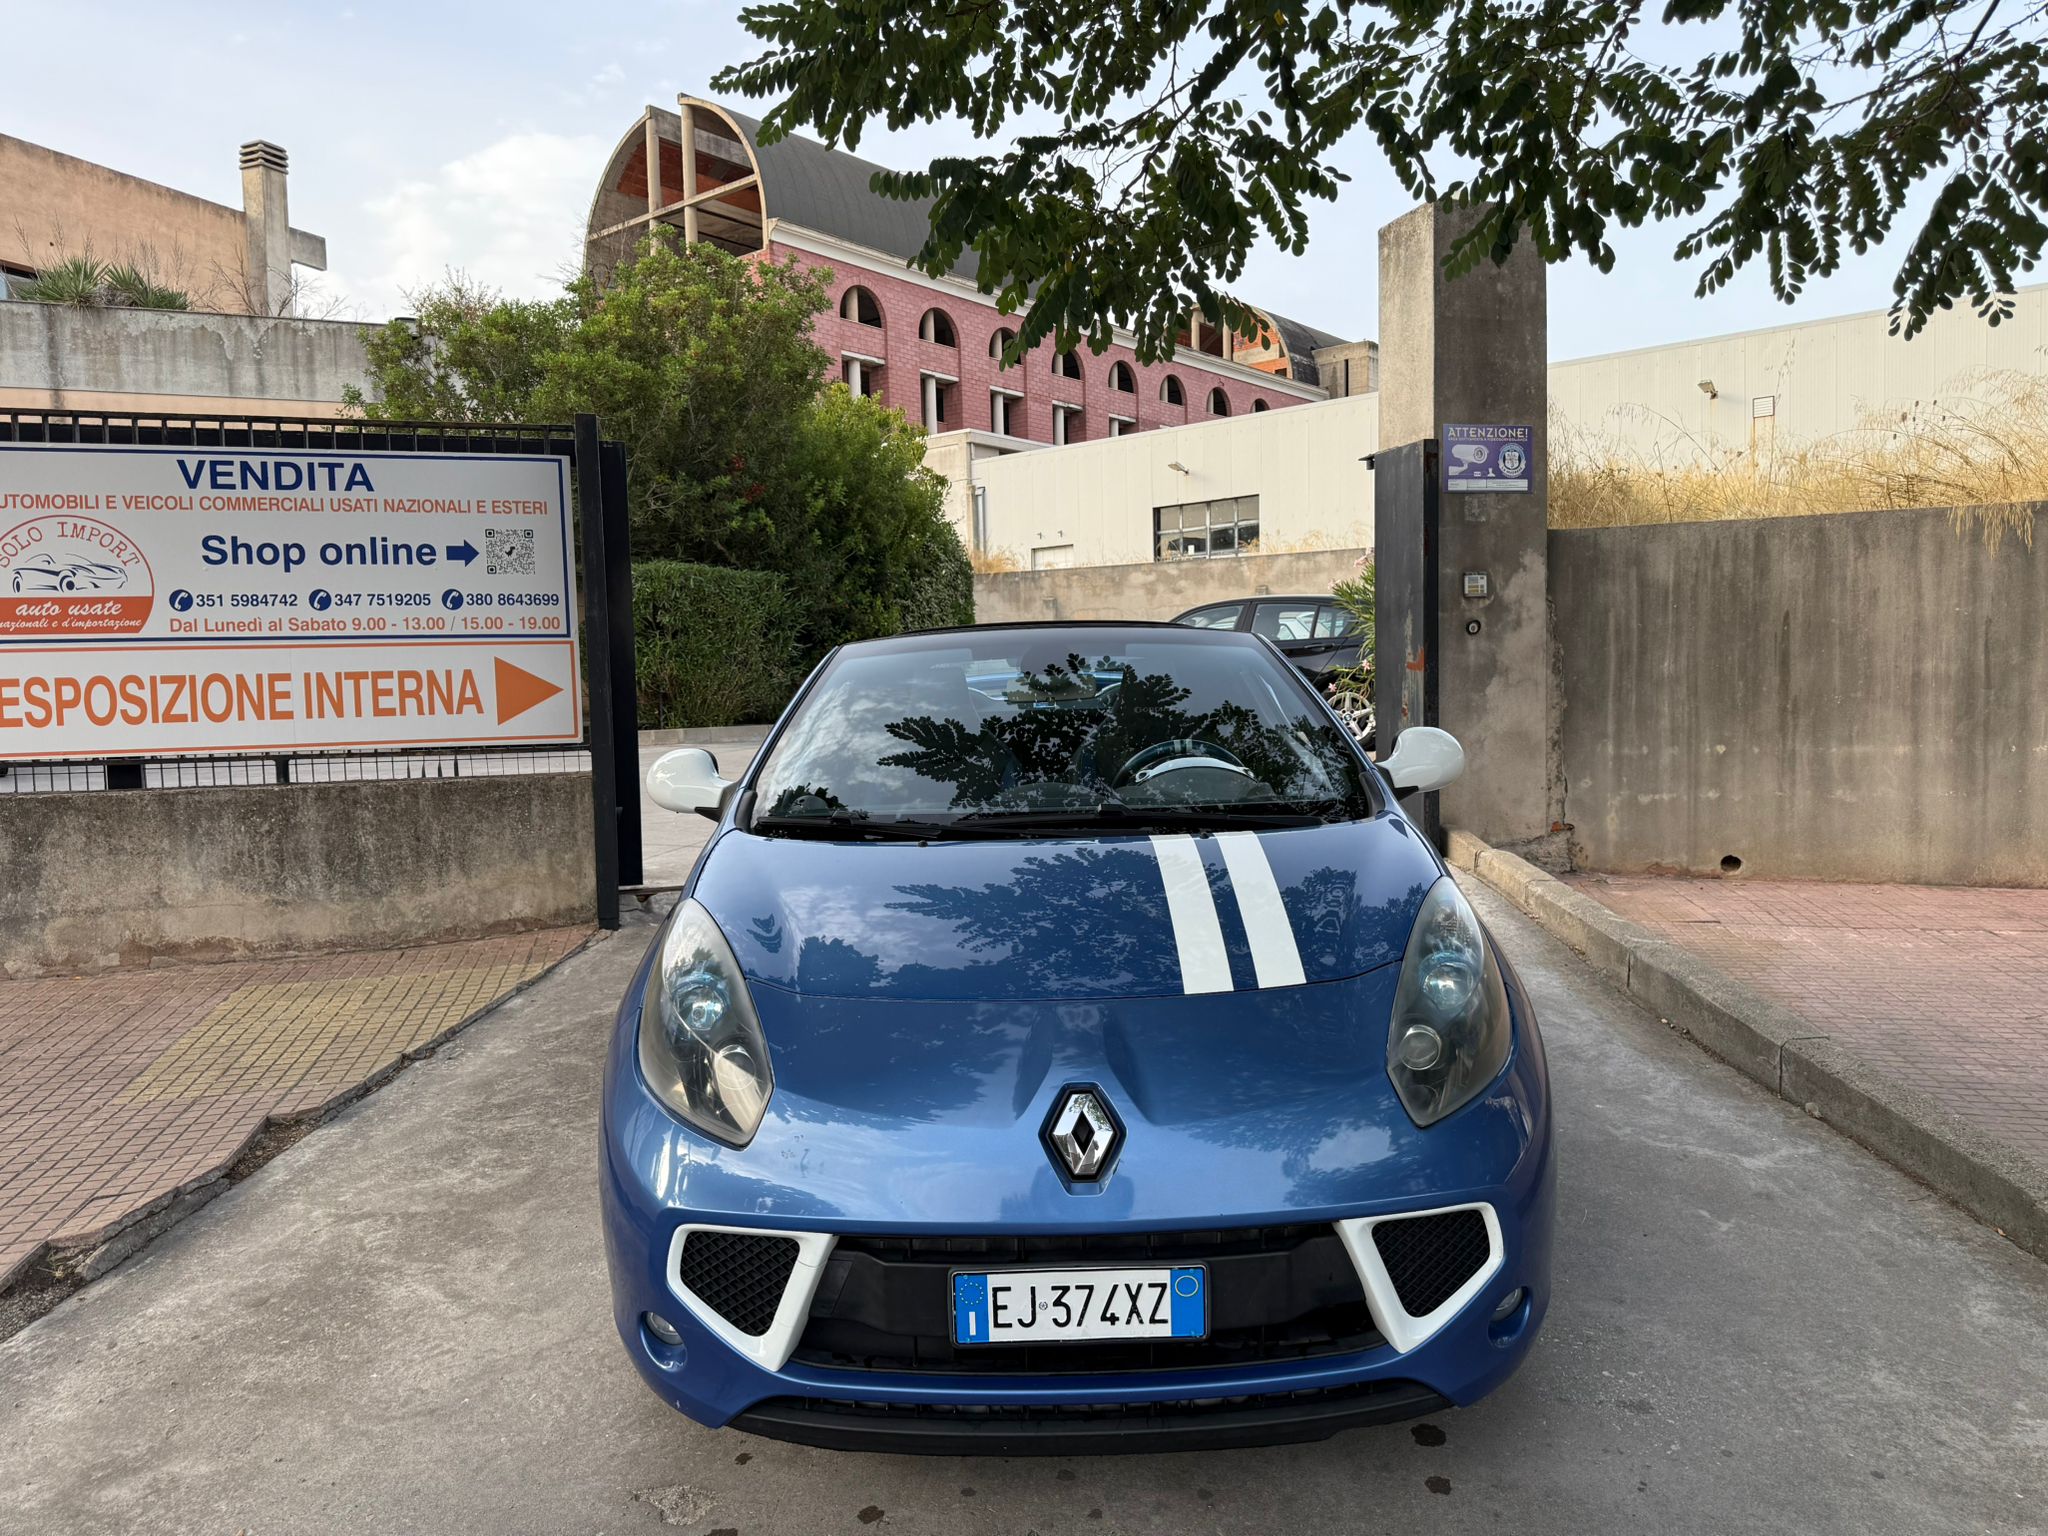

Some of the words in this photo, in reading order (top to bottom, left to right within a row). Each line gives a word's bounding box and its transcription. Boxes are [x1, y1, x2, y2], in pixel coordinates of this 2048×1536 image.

[1448, 427, 1528, 438] ATTENZIONE!
[176, 459, 375, 492] VENDITA
[106, 495, 117, 510] E
[122, 495, 193, 511] VEICOLI
[200, 496, 324, 512] COMMERCIALI
[330, 498, 378, 513] USATI
[383, 498, 471, 514] NAZIONALI
[476, 500, 487, 514] E
[492, 500, 548, 515] ESTERI
[57, 521, 141, 567] IMPORT
[202, 534, 306, 573] Shop
[320, 536, 437, 566] online
[15, 600, 61, 616] auto
[68, 600, 122, 616] usate
[196, 593, 224, 607] 351
[230, 593, 298, 607] 5984742
[334, 593, 361, 607] 347
[367, 593, 431, 606] 7519205
[466, 593, 493, 606] 380
[498, 593, 559, 606] 8643699
[61, 616, 142, 630] d'importazione
[169, 618, 198, 633] Dal
[204, 616, 262, 632] Lunedì
[268, 617, 282, 632] al
[288, 617, 347, 632] Sabato
[352, 617, 386, 631] 9.00
[402, 617, 446, 631] 13.00
[461, 616, 504, 630] 15.00
[519, 616, 560, 630] 19.00
[0, 672, 294, 729] ESPOSIZIONE
[304, 668, 485, 719] INTERNA
